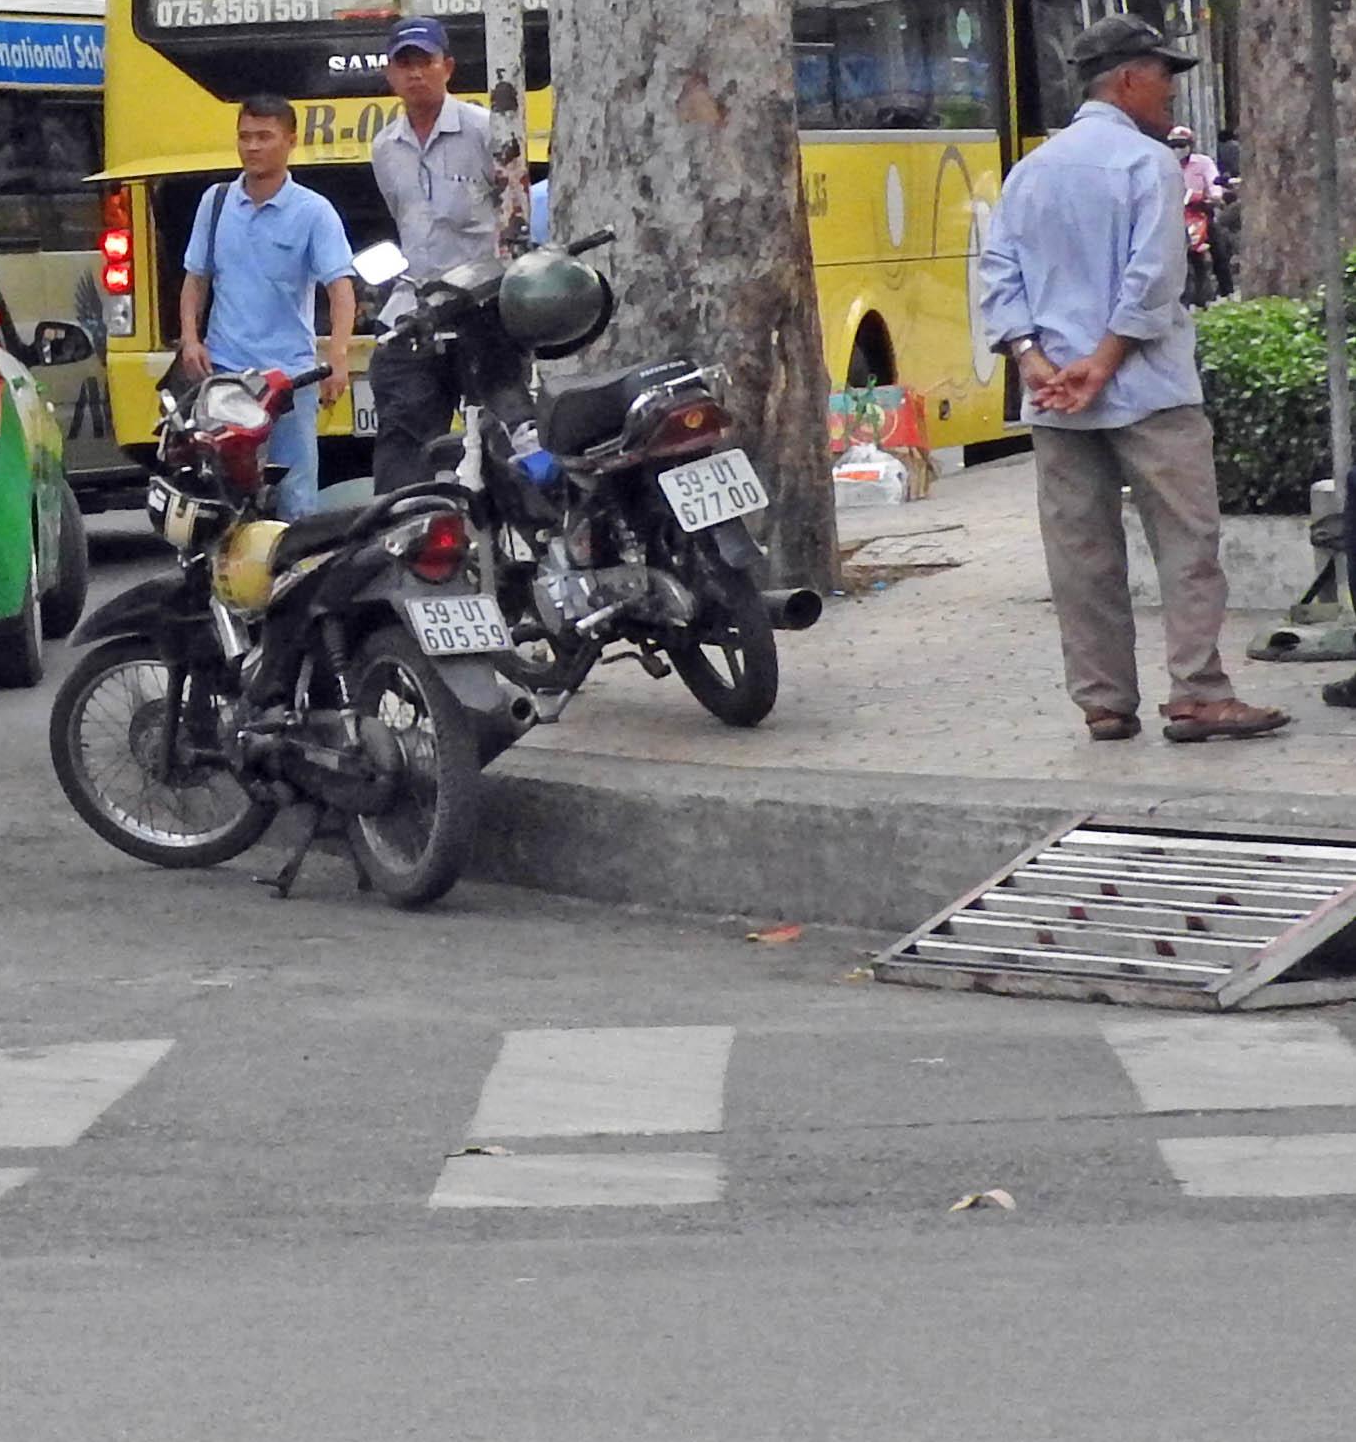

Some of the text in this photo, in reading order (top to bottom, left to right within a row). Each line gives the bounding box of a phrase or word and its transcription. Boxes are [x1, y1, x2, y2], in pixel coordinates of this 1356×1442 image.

[327, 54, 390, 72] SAM
[674, 458, 738, 498] 59-U1
[679, 481, 760, 527] 677.00
[422, 600, 486, 625] 59-U1
